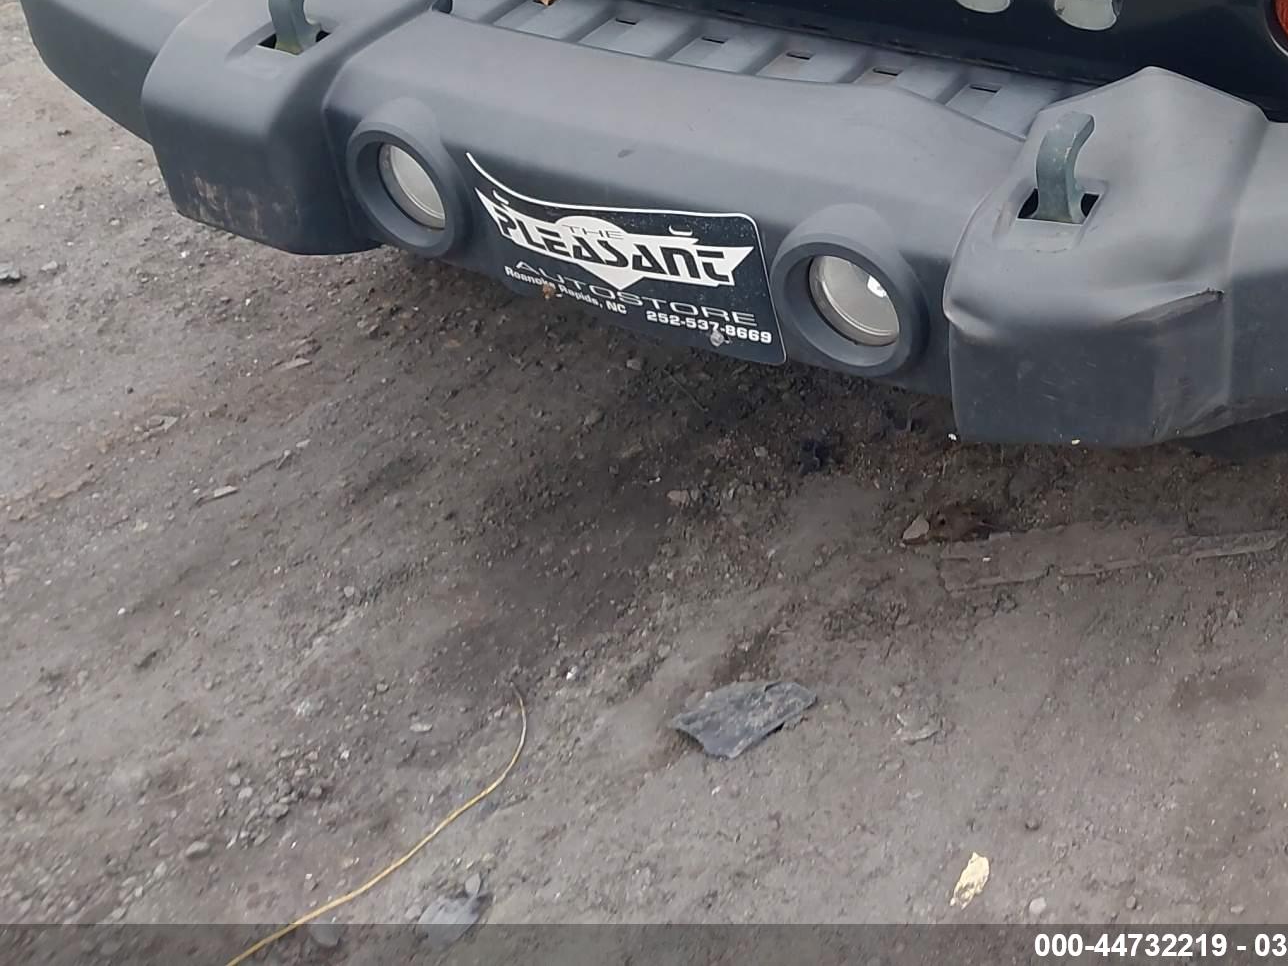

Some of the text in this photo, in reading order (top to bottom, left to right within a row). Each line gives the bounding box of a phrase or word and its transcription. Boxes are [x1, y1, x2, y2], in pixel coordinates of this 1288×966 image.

[492, 205, 731, 283] PLEASANT
[561, 224, 625, 240] THE
[605, 299, 628, 315] NC
[646, 310, 772, 344] 252-537-8669
